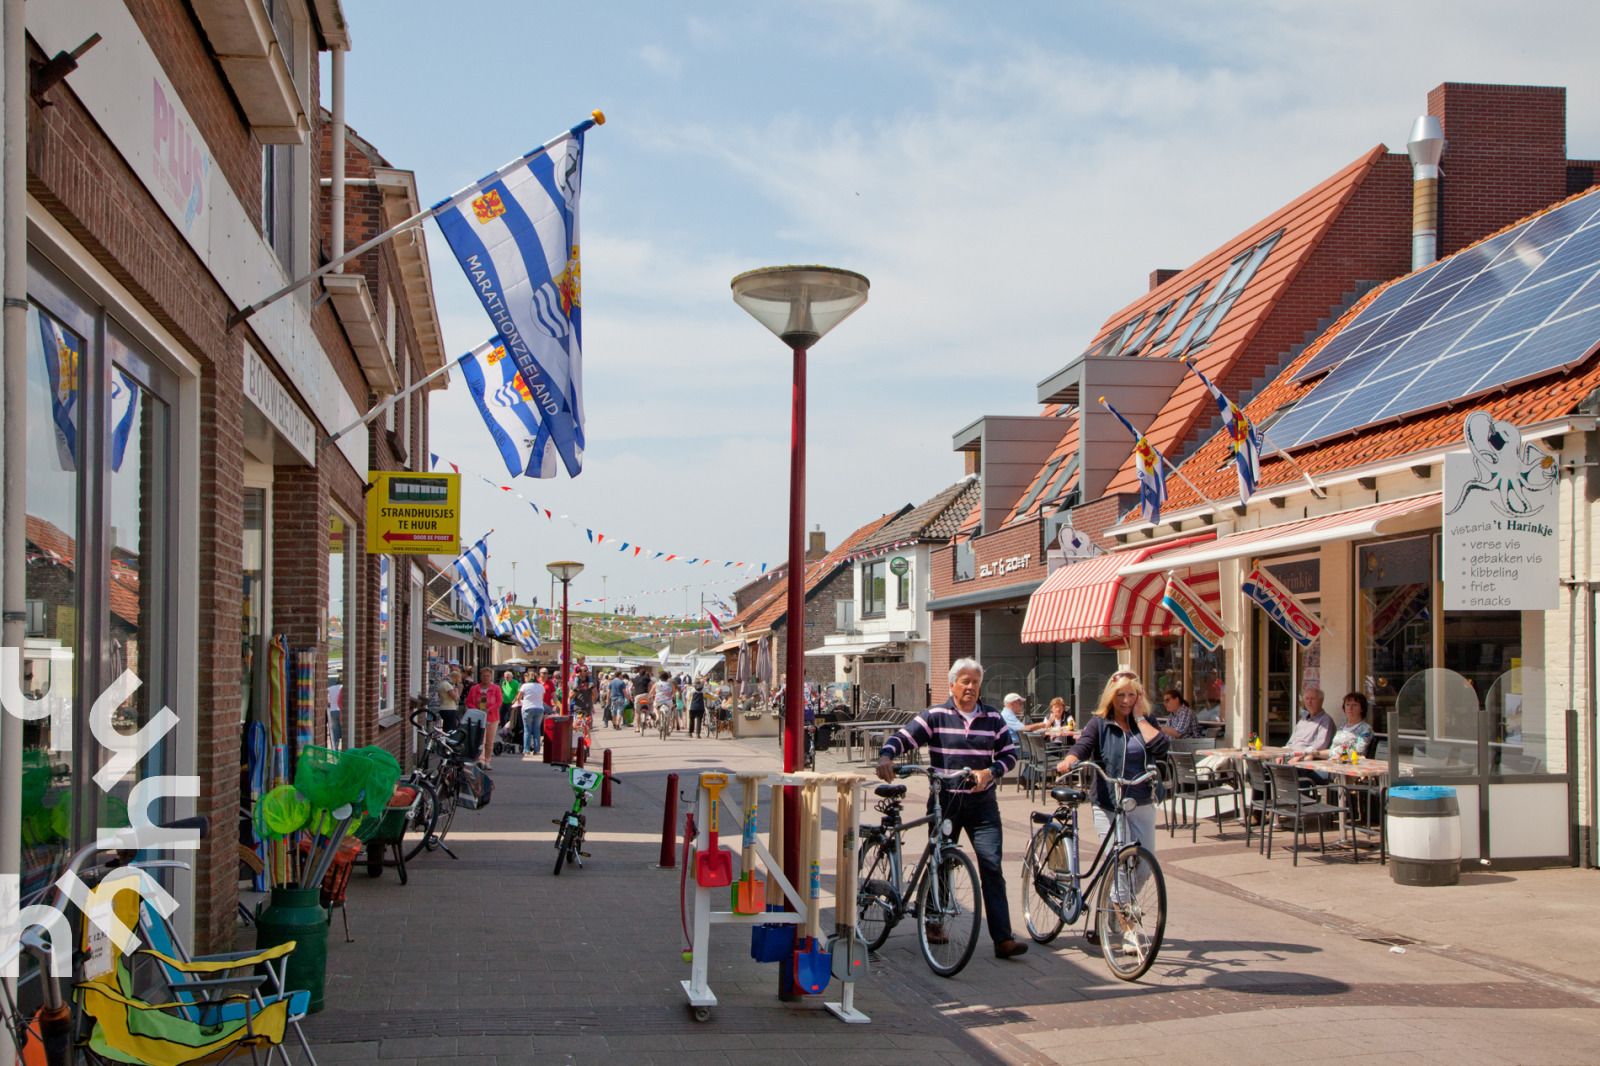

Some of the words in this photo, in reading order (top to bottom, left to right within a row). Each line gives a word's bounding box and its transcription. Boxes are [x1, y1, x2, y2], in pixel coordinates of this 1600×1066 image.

[153, 76, 204, 216] PLUS
[466, 254, 559, 417] MARATHONZEELAND
[381, 507, 454, 518] STRANDHUISJES
[398, 520, 408, 529] TE
[411, 520, 437, 530] HUUR
[1450, 522, 1492, 536] vistaria
[1507, 520, 1553, 536] Harinkje
[1470, 540, 1502, 550] verse
[1505, 539, 1521, 550] vis
[1470, 553, 1523, 566] gebakken
[1526, 553, 1543, 564] vis
[1470, 567, 1519, 580] kibbeling
[1470, 580, 1497, 592] friet
[1470, 595, 1512, 607] snacks
[1252, 575, 1314, 642] VIS
